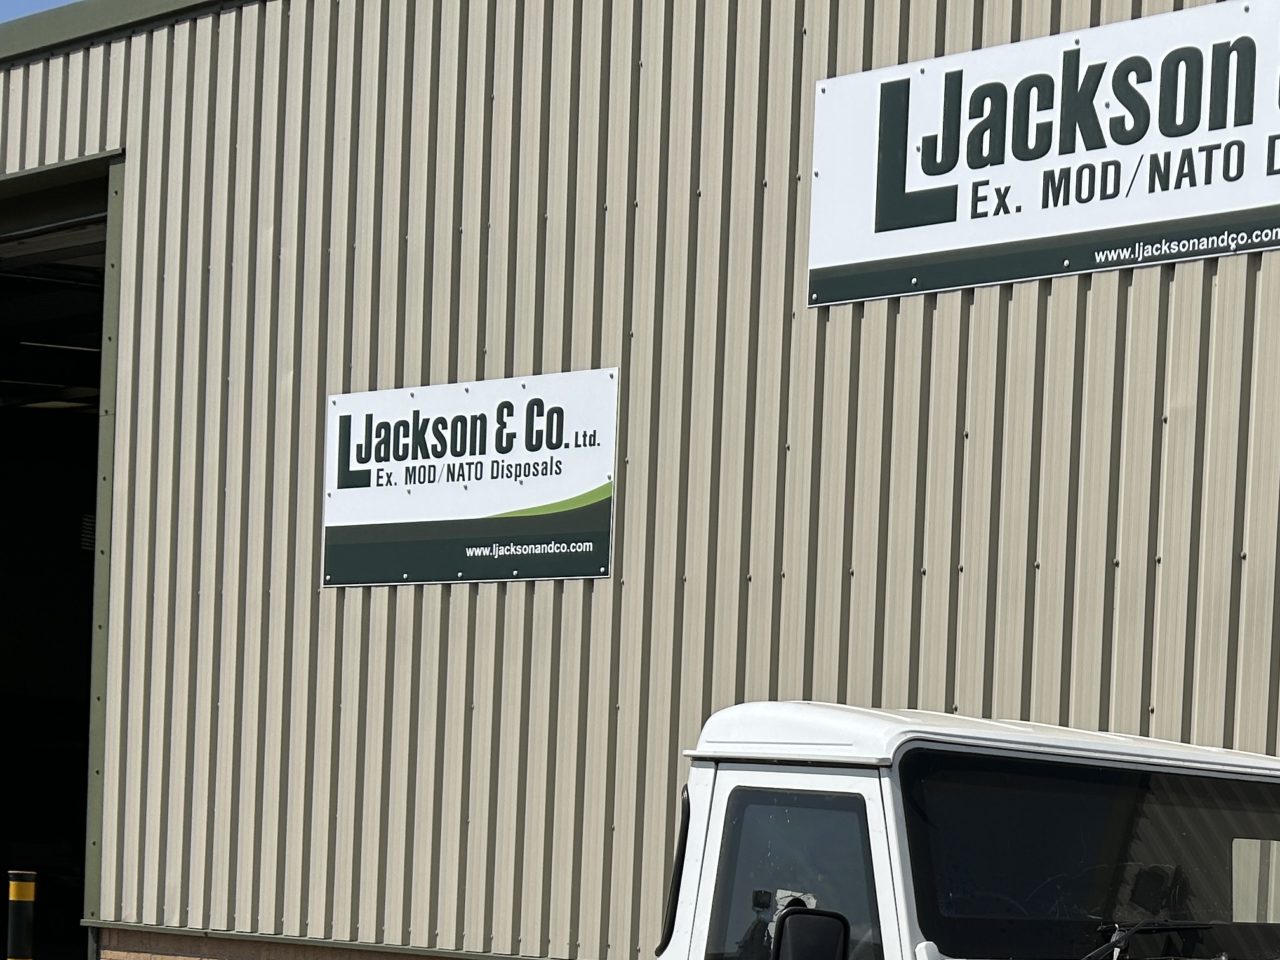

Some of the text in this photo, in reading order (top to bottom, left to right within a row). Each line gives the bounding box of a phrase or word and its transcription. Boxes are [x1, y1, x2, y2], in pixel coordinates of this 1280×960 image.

[970, 179, 1022, 220] Ex.
[1041, 139, 1246, 210] MOD/NATO
[495, 400, 517, 455] &
[524, 398, 571, 453] Co.
[574, 429, 601, 449] Ltd.
[376, 456, 563, 487] Ex. MOD/NATO Disposals
[465, 540, 593, 558] www.ljacksonandco.com
